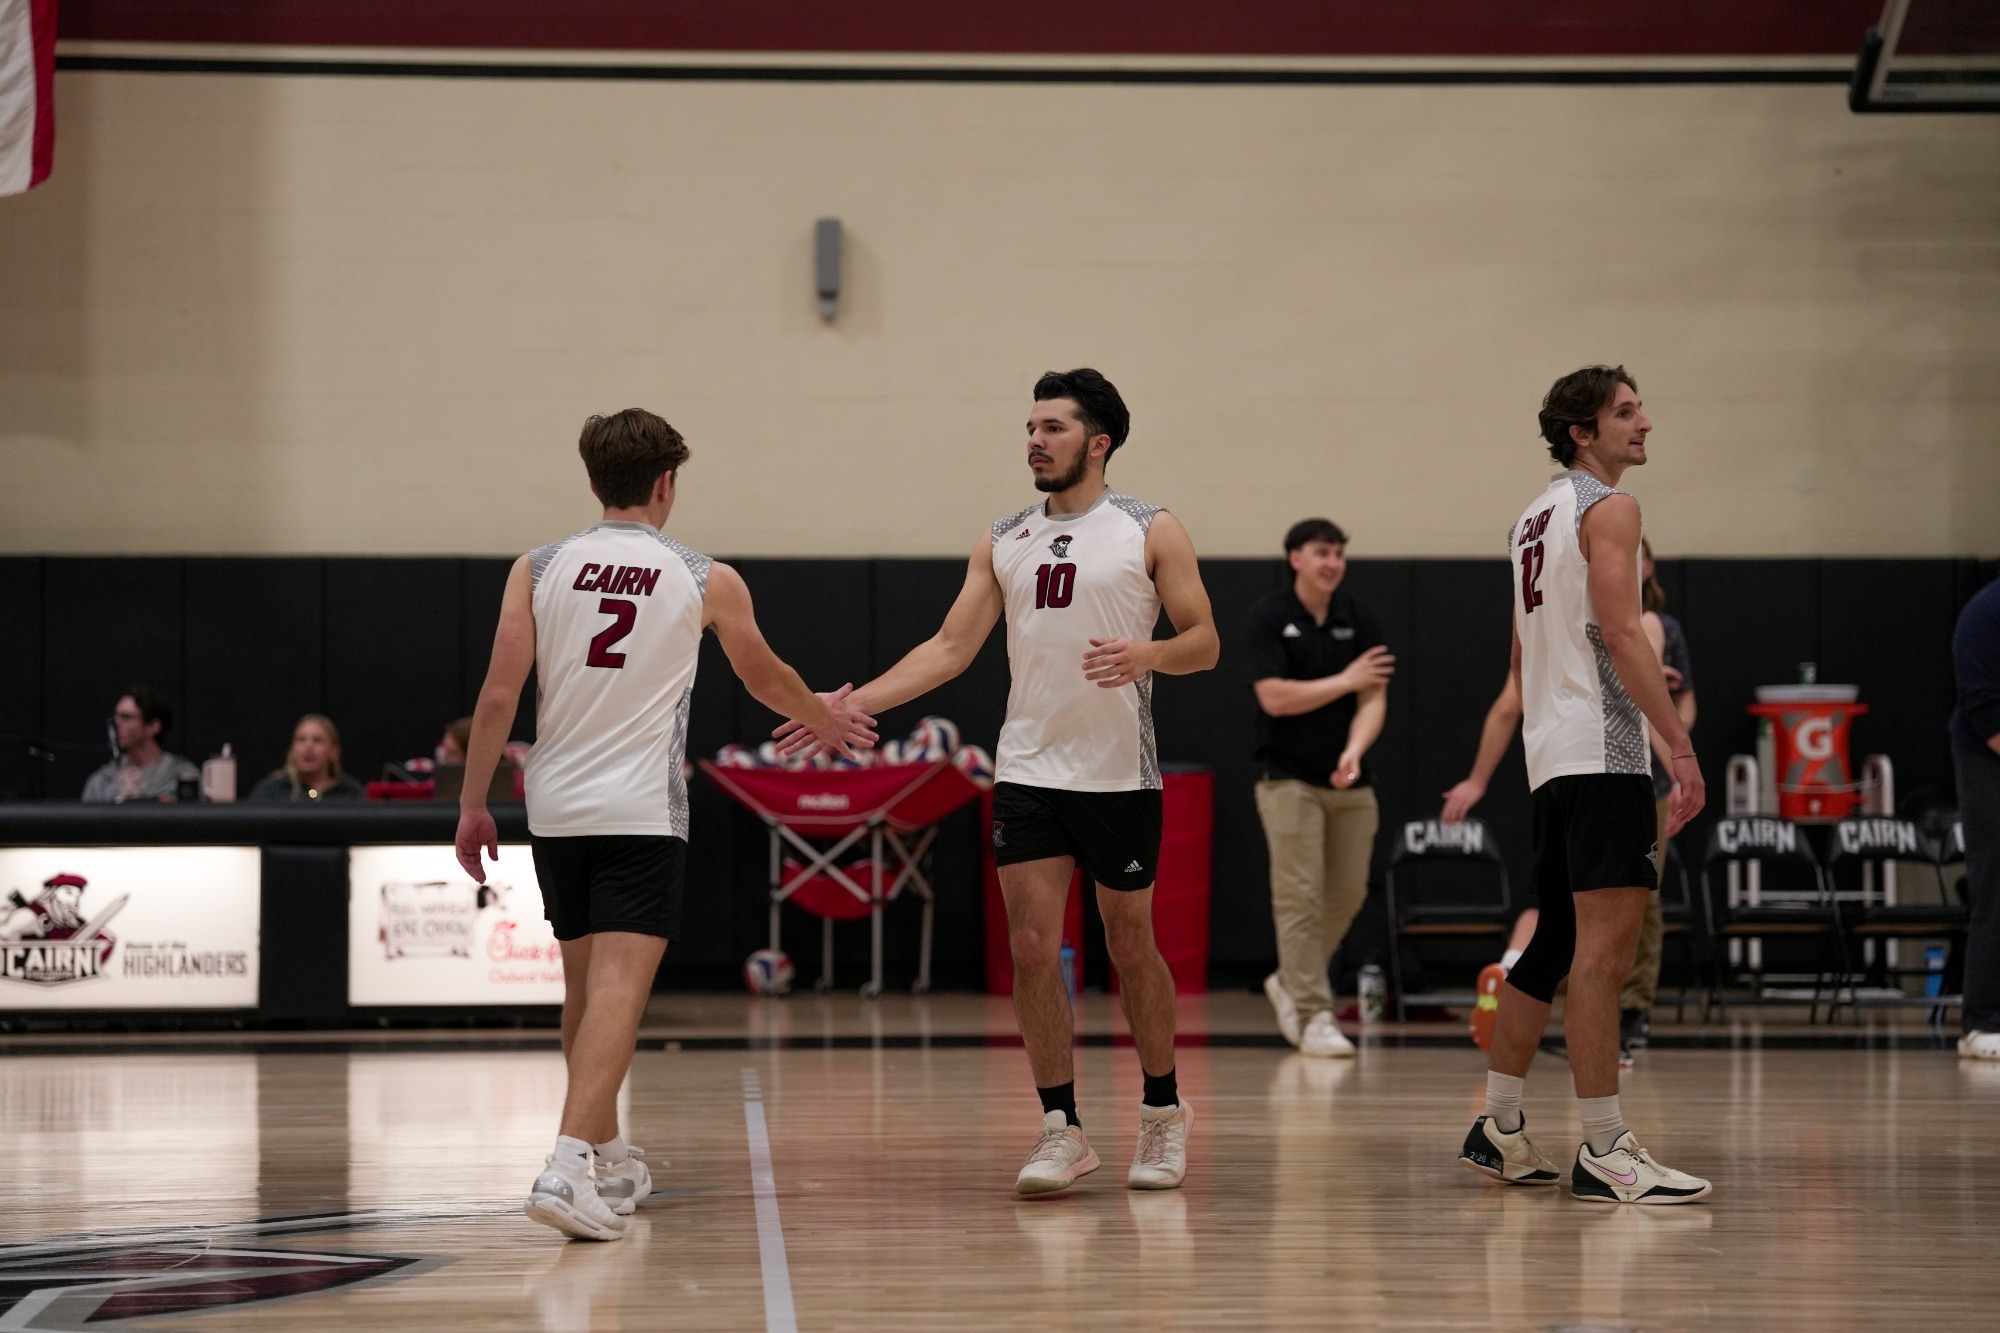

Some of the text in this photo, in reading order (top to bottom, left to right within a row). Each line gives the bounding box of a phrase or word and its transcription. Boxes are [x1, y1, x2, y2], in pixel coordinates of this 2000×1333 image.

[572, 562, 662, 597] CAIRN
[1035, 562, 1077, 609] 10
[1521, 540, 1544, 614] 12
[585, 598, 638, 669] 2
[1795, 716, 1834, 761] G
[1717, 818, 1797, 854] CAIRN
[1838, 819, 1917, 854] CAIRN
[6, 945, 93, 978] CAIRN
[123, 951, 248, 977] HIGHLANDERS
